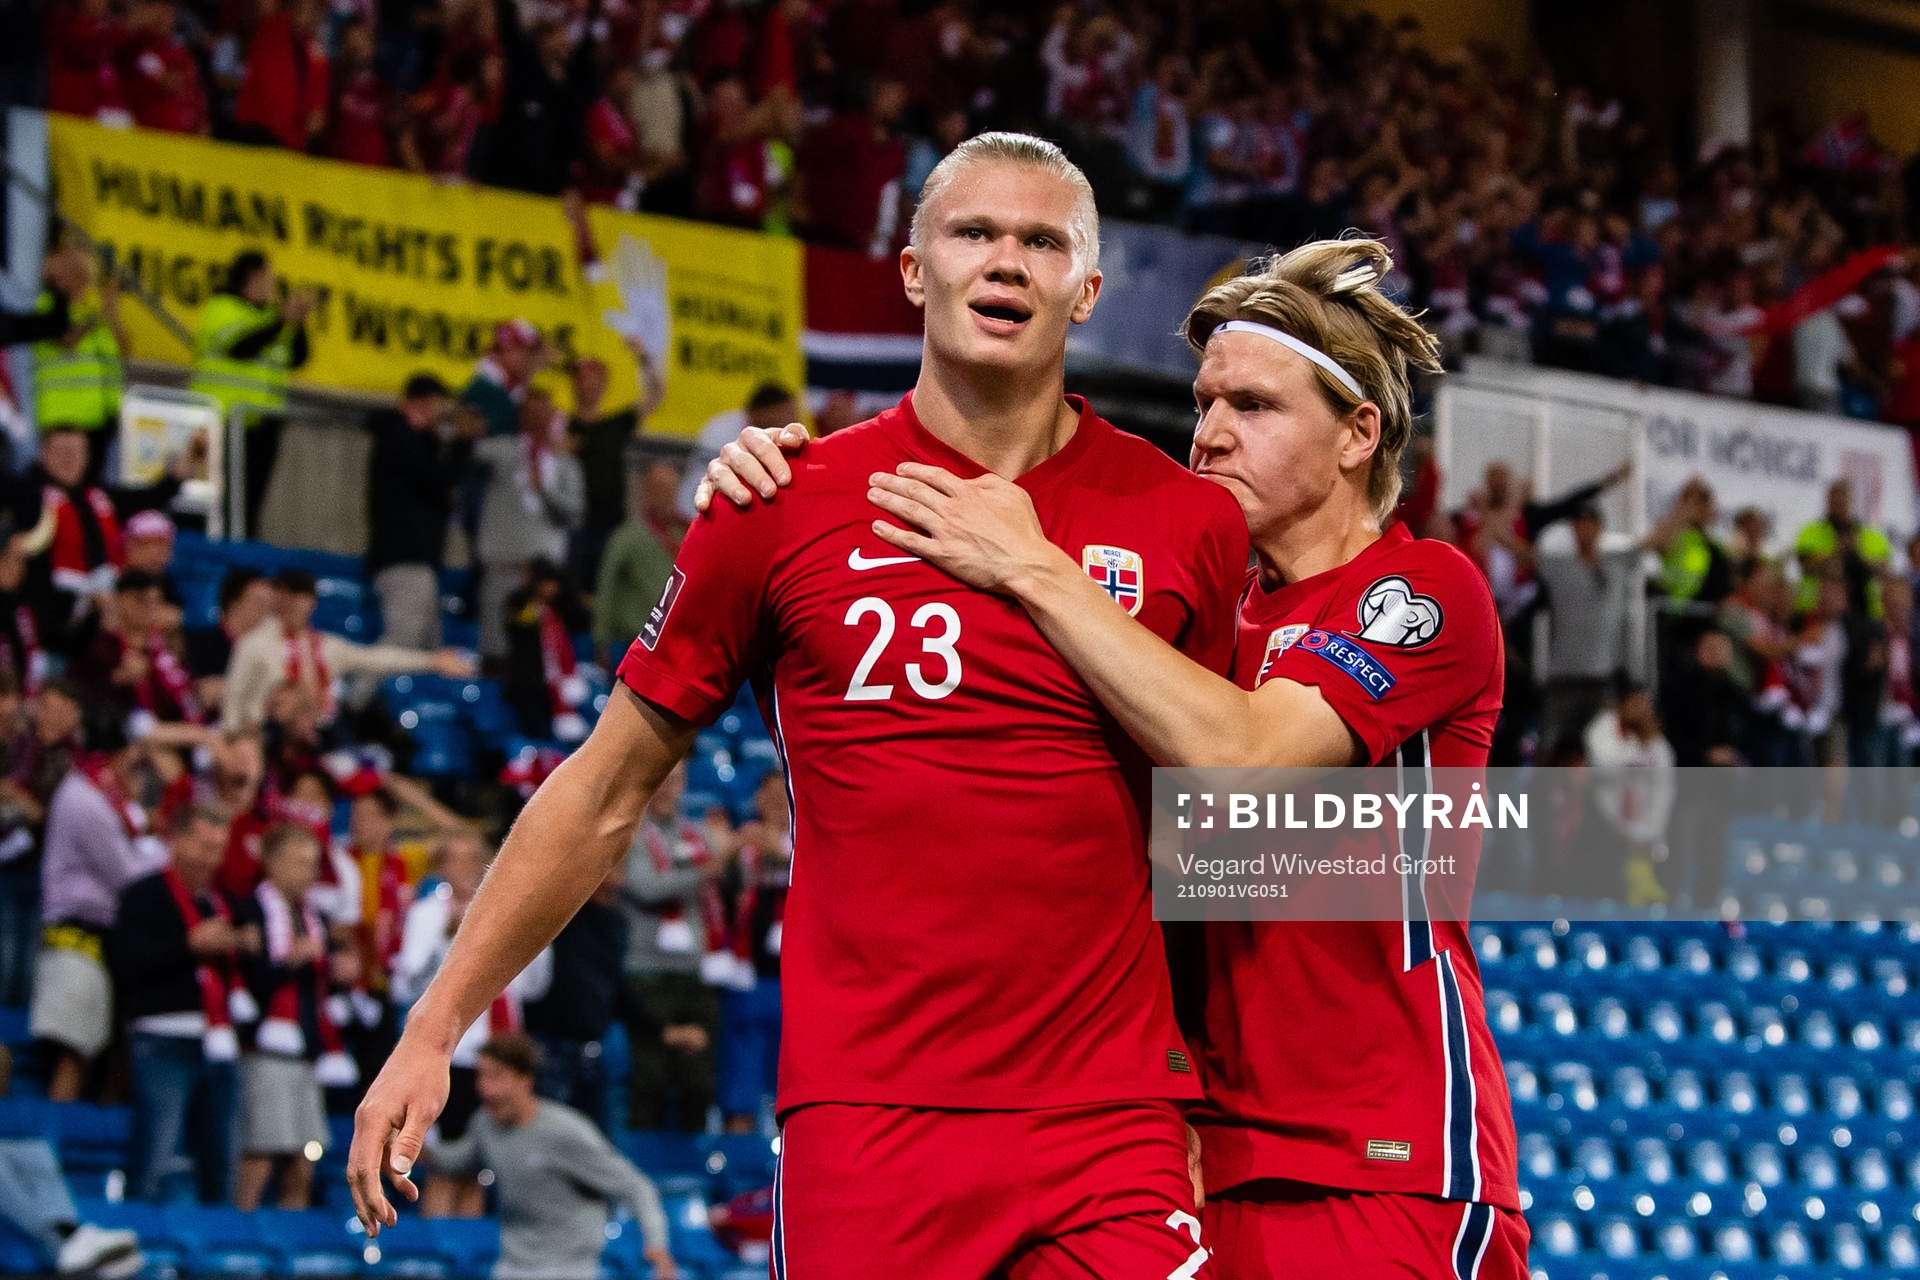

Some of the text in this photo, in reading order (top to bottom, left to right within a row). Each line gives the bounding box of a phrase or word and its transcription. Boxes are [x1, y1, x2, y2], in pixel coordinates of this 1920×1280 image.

[91, 157, 569, 297] HUMAN RIGHTS FOR
[344, 289, 577, 376] WORKS
[844, 597, 961, 700] 23
[1325, 641, 1391, 692] RESPECT
[1166, 1209, 1214, 1280] 2
